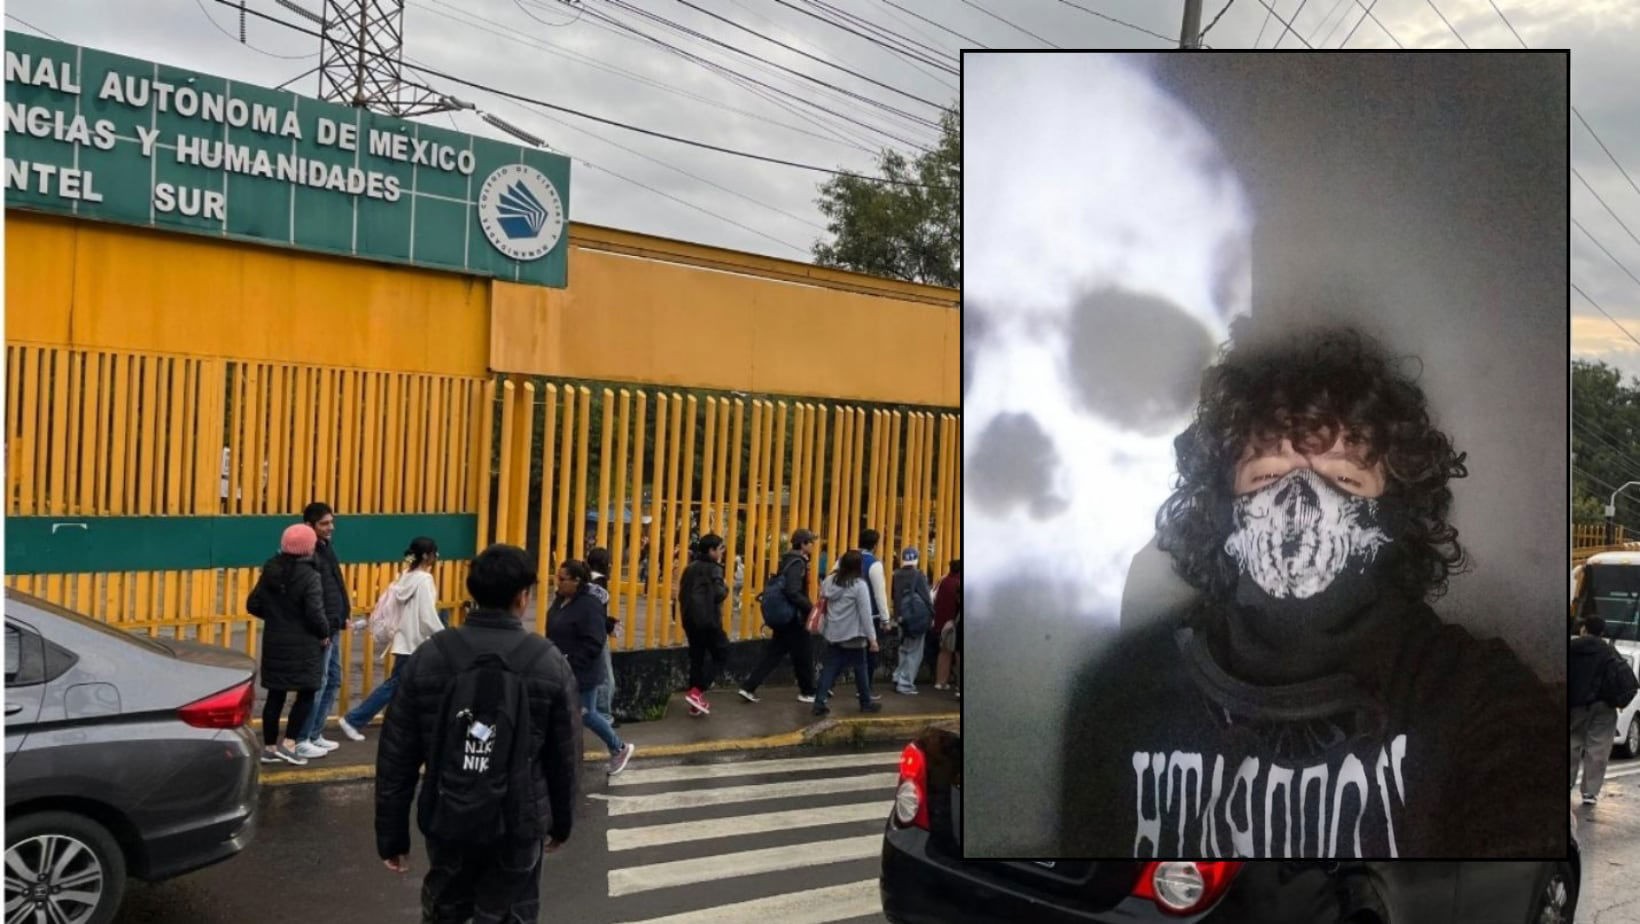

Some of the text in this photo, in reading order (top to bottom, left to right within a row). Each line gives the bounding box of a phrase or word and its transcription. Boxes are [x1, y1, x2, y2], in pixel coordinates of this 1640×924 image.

[5, 101, 400, 202] NCIAS Y HUMANIDADES
[6, 50, 476, 175] NAL AUTÓNOMA DE MÉXICO
[5, 158, 225, 220] NTEL SUR
[463, 755, 489, 772] NIK
